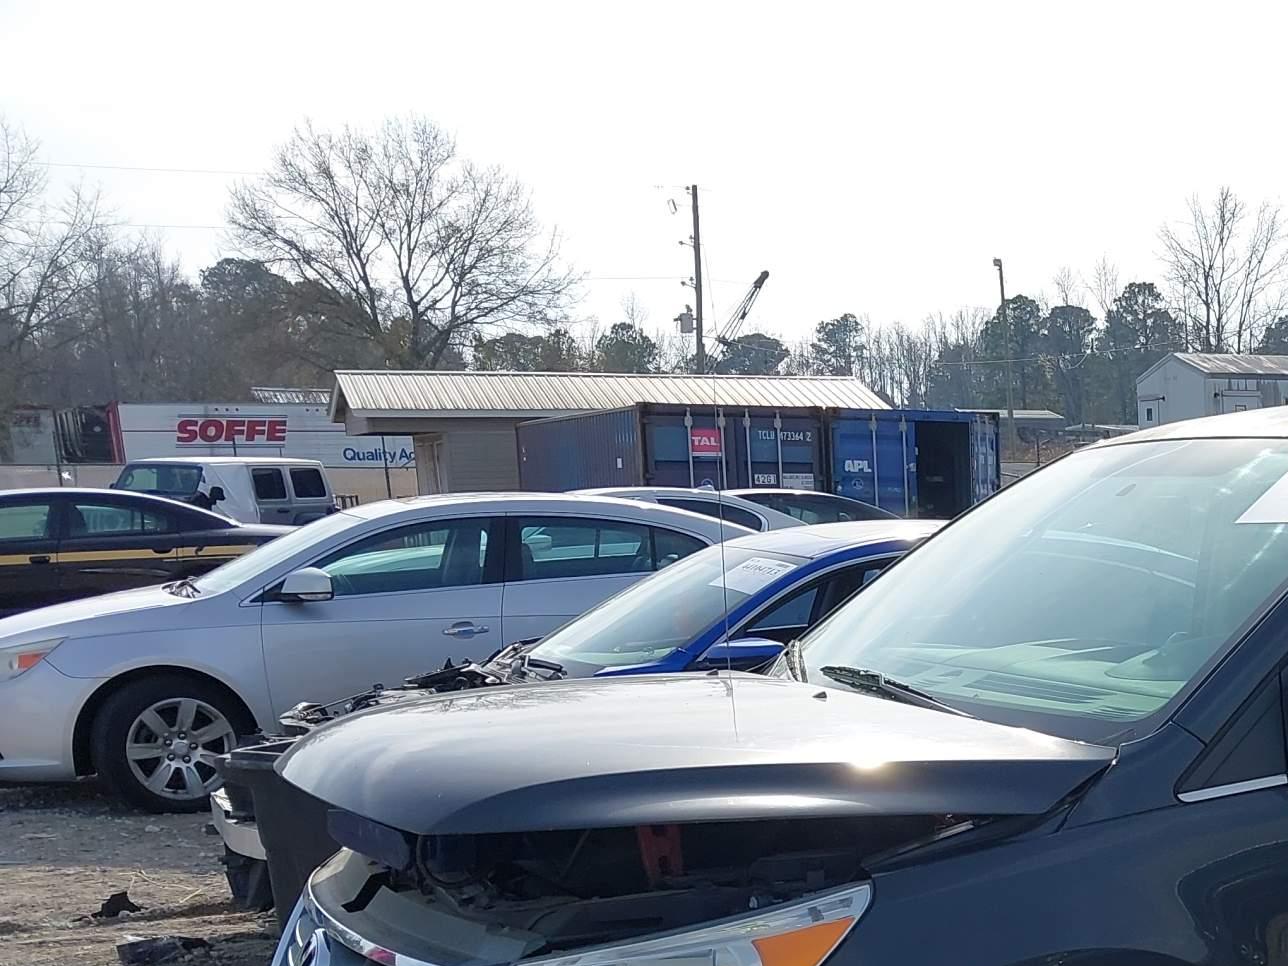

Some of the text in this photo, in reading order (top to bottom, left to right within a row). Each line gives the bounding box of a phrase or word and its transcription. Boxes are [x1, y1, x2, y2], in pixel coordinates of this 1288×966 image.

[177, 419, 287, 443] SOFFE
[692, 437, 720, 446] TAL
[844, 460, 872, 472] APL
